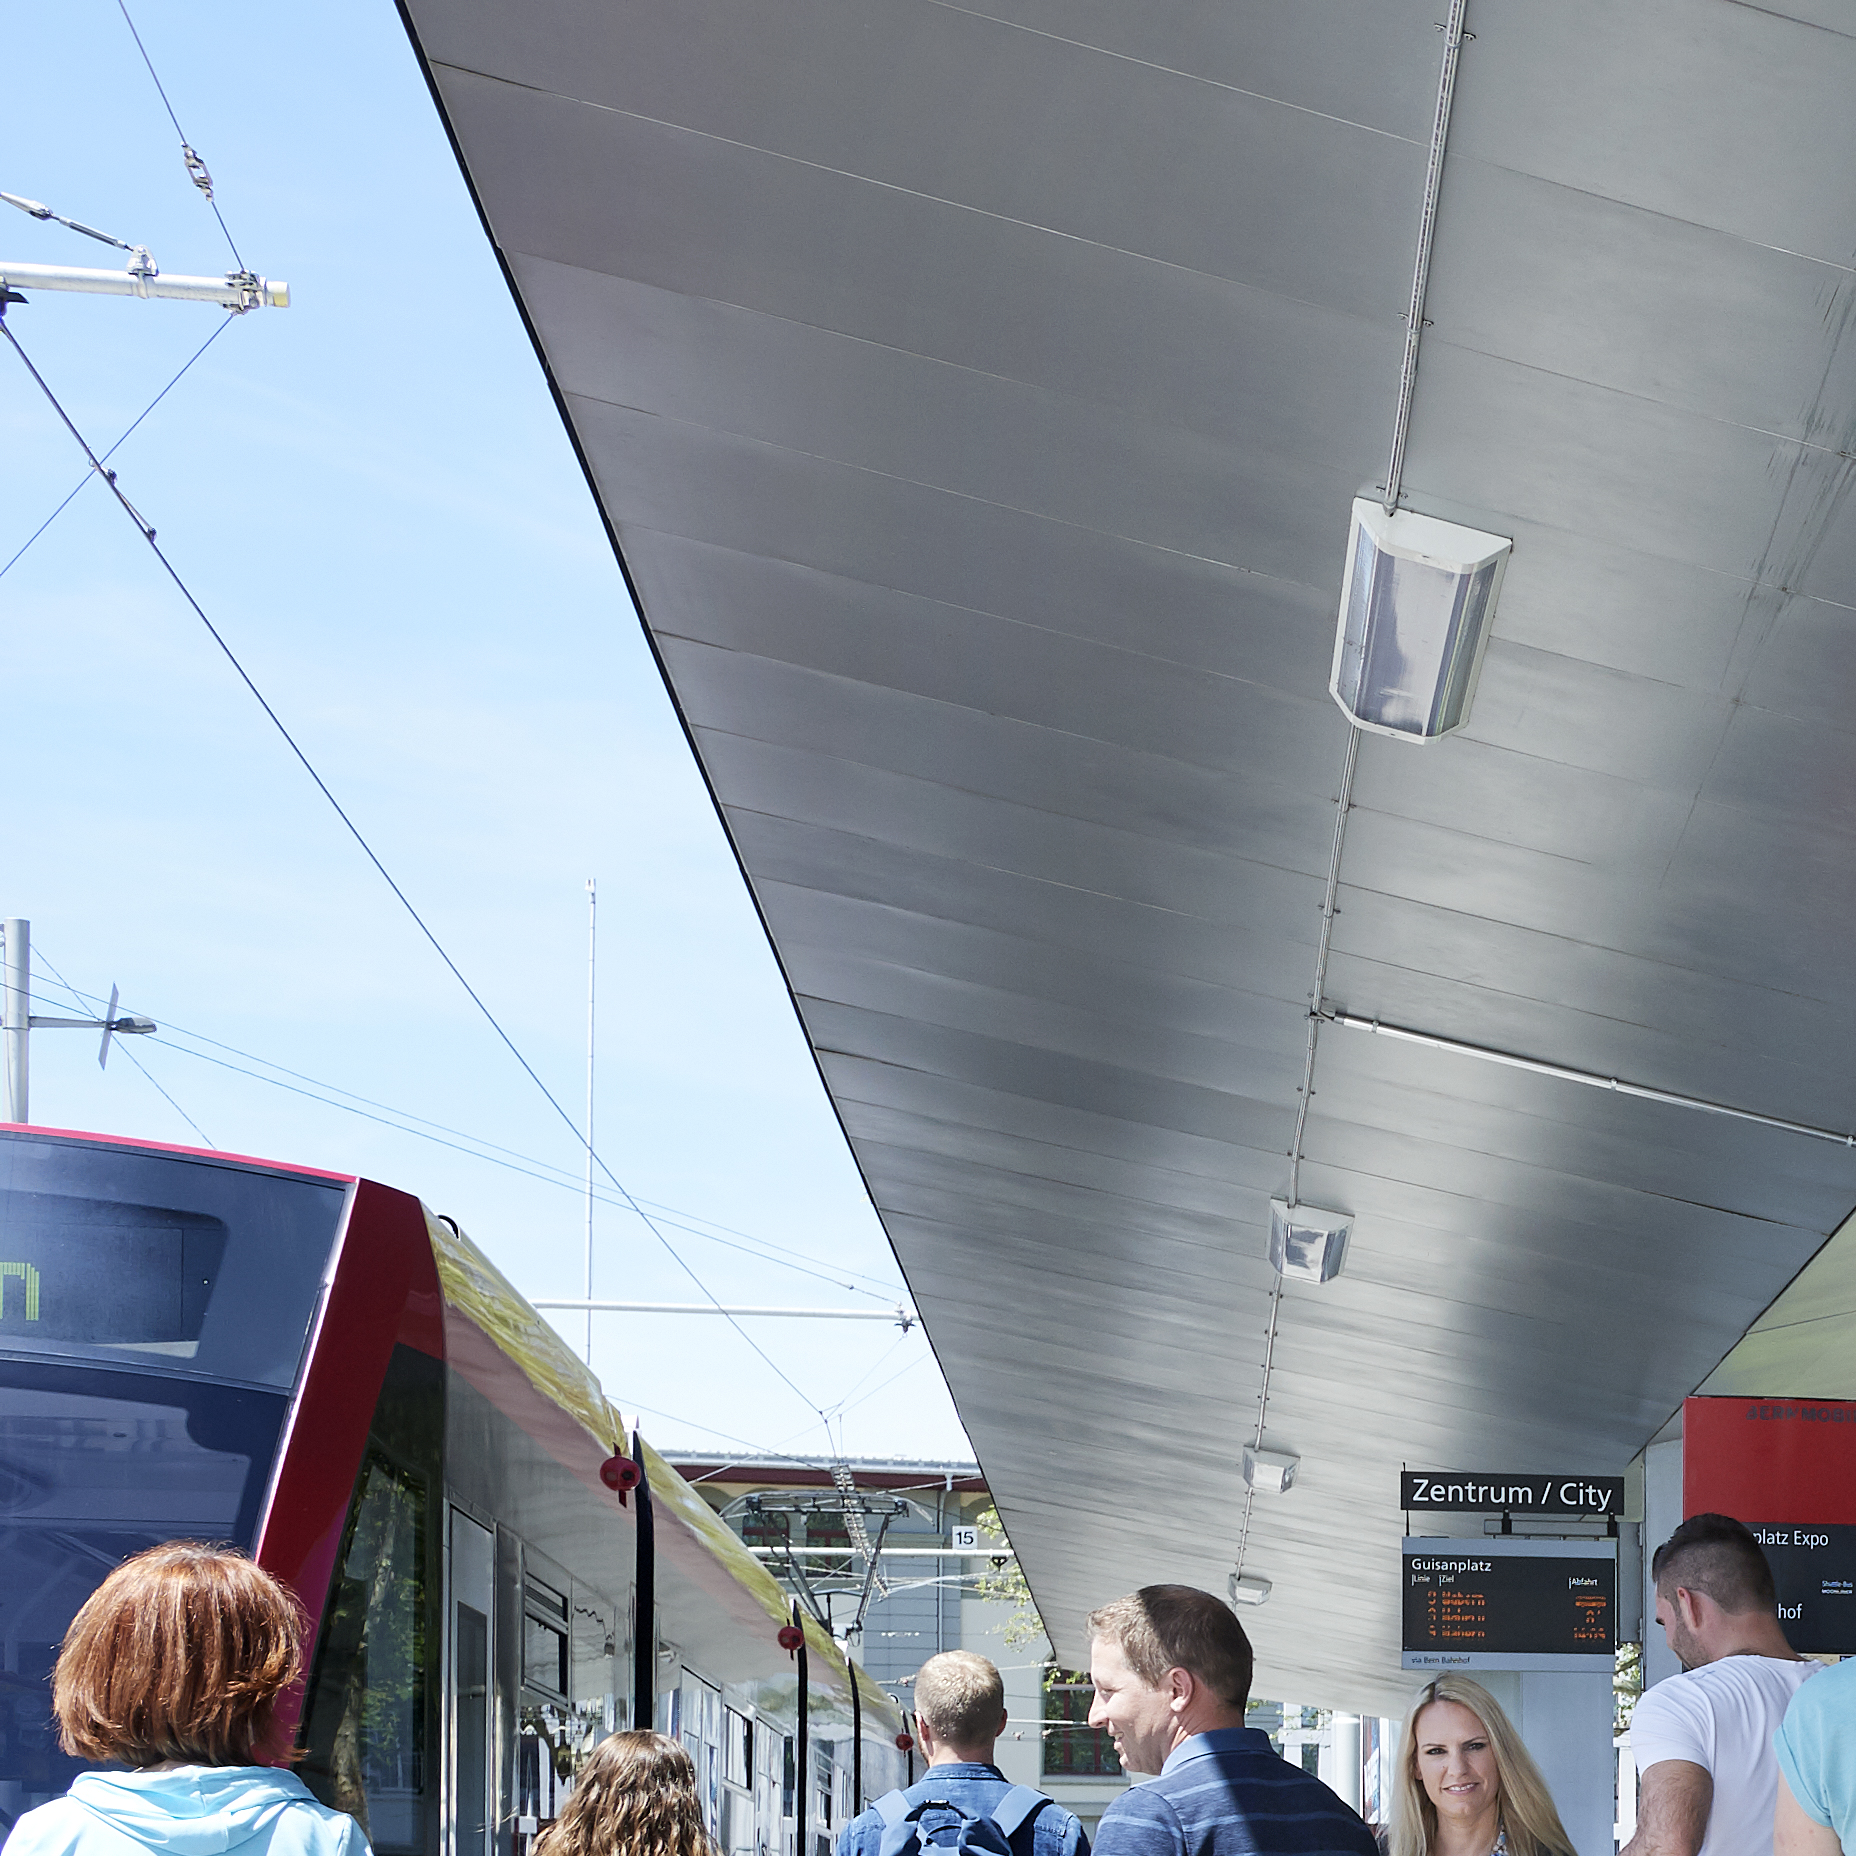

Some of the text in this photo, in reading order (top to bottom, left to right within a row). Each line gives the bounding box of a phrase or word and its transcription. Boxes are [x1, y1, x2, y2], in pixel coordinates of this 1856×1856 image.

[1411, 1478, 1533, 1505] Zentrum
[1559, 1481, 1613, 1513] City
[955, 1530, 975, 1546] 15
[1793, 1529, 1829, 1550] Expo
[1411, 1558, 1493, 1574] Guisanplatz
[1777, 1602, 1803, 1620] hof
